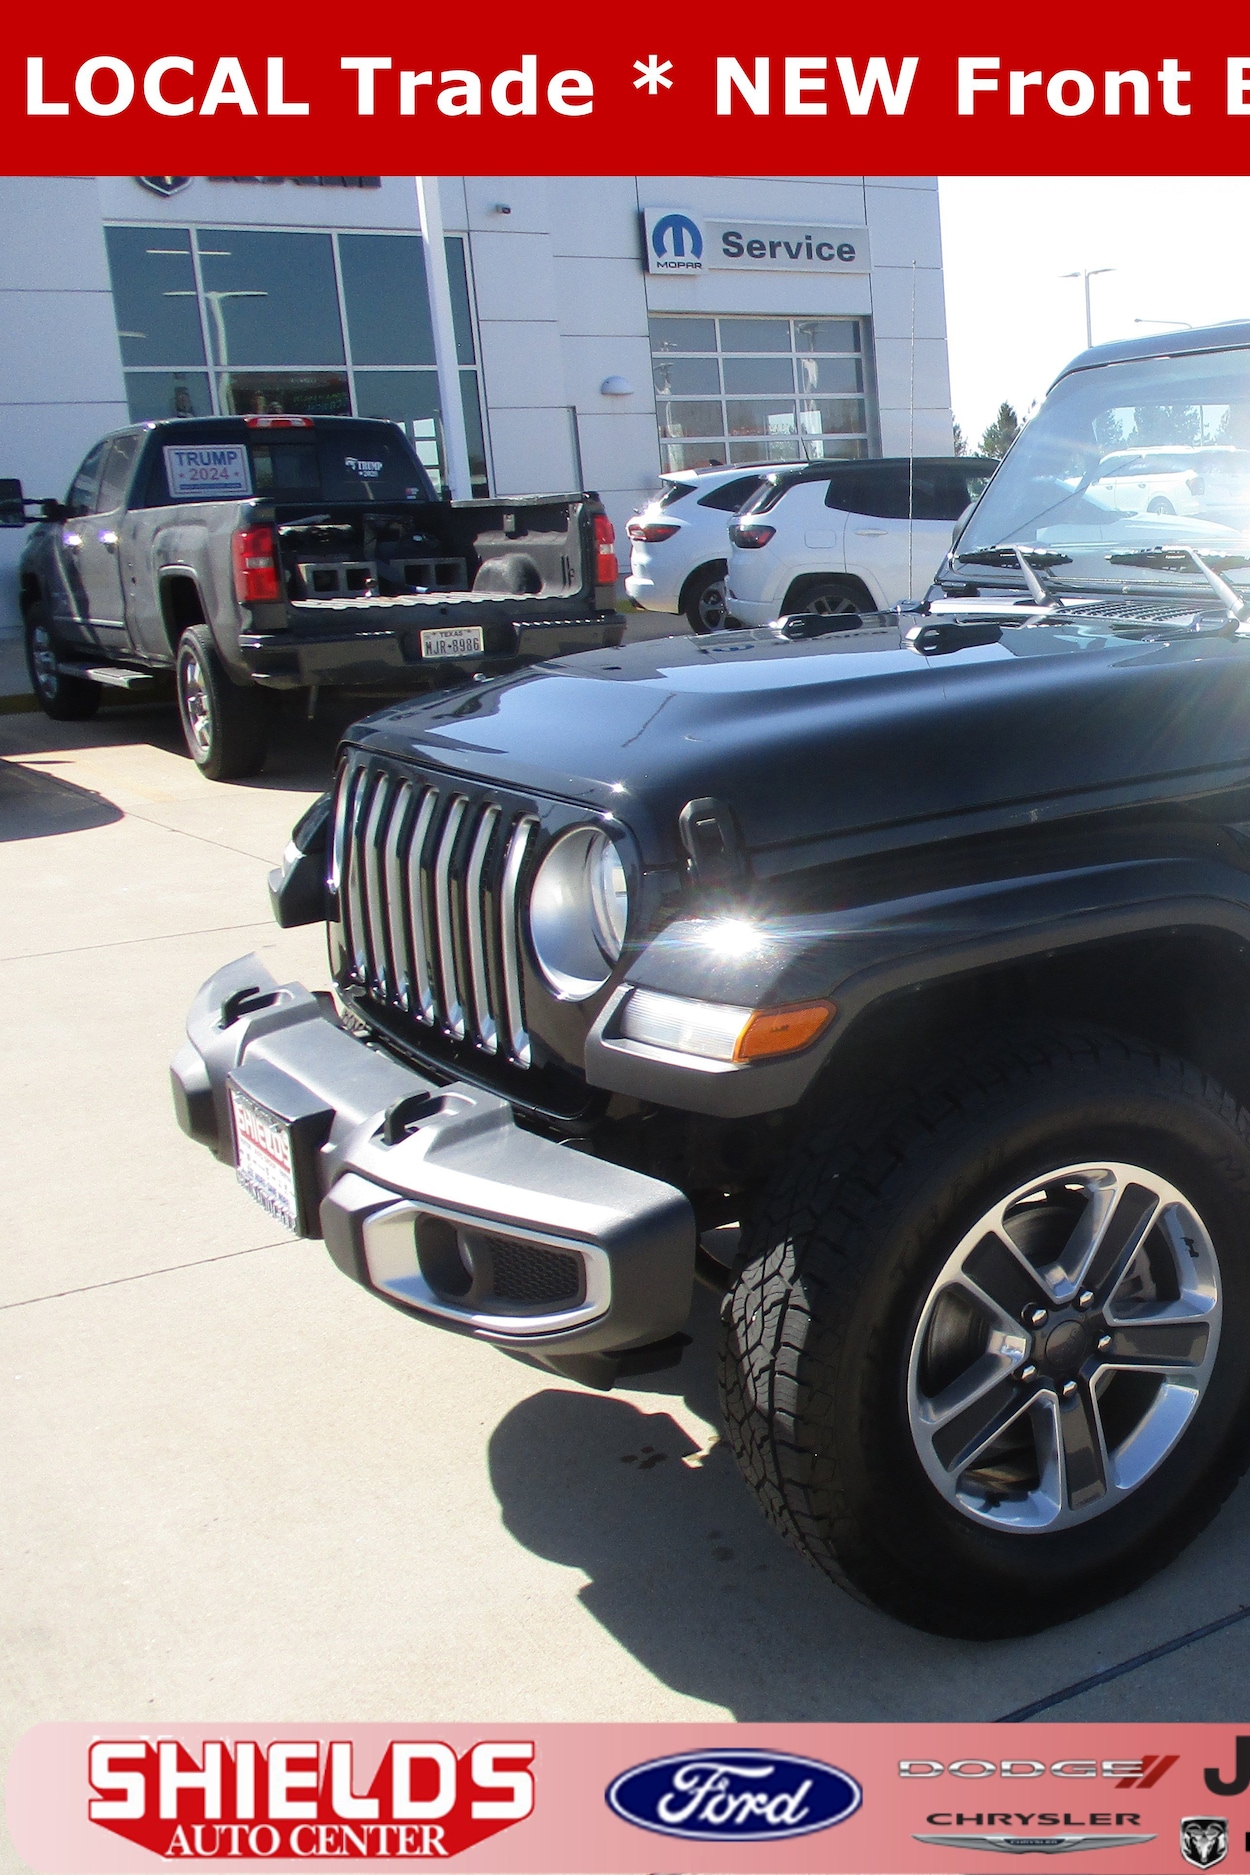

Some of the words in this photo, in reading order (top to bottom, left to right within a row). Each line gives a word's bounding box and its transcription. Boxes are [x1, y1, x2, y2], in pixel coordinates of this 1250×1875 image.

[721, 231, 857, 262] Service
[656, 261, 702, 270] MOPAR
[174, 450, 238, 467] TRUMP
[189, 467, 229, 481] 2024
[440, 630, 463, 638] TEXAS
